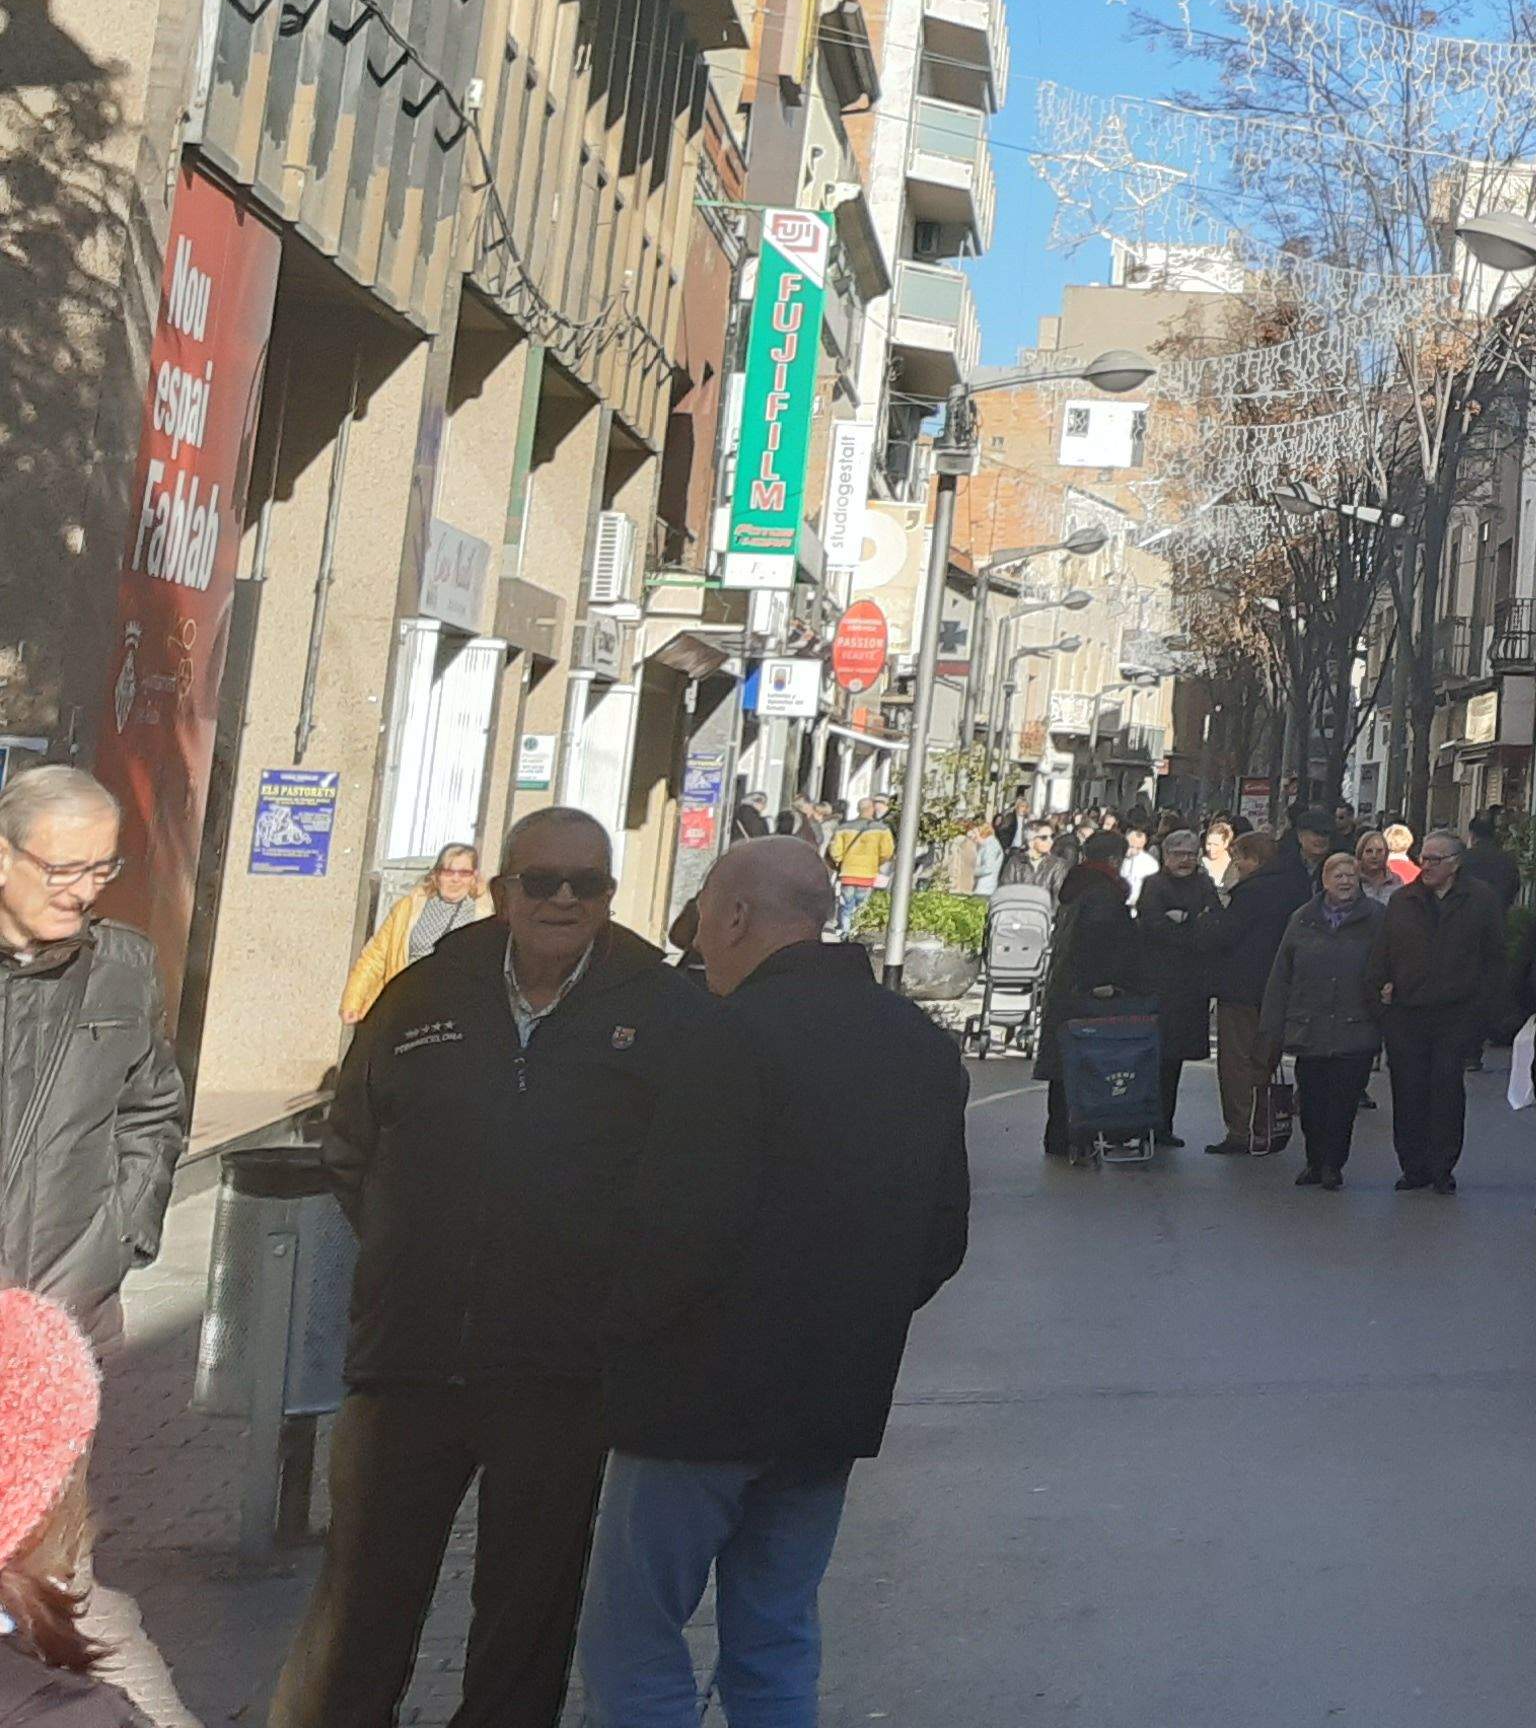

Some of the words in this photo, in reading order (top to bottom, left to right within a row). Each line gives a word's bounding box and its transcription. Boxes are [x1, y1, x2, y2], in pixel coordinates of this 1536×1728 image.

[166, 234, 212, 343] Nou
[153, 359, 213, 461] espai
[750, 272, 803, 511] FUJIFILM
[132, 458, 221, 592] Fablab
[829, 434, 856, 549] studiogestalt
